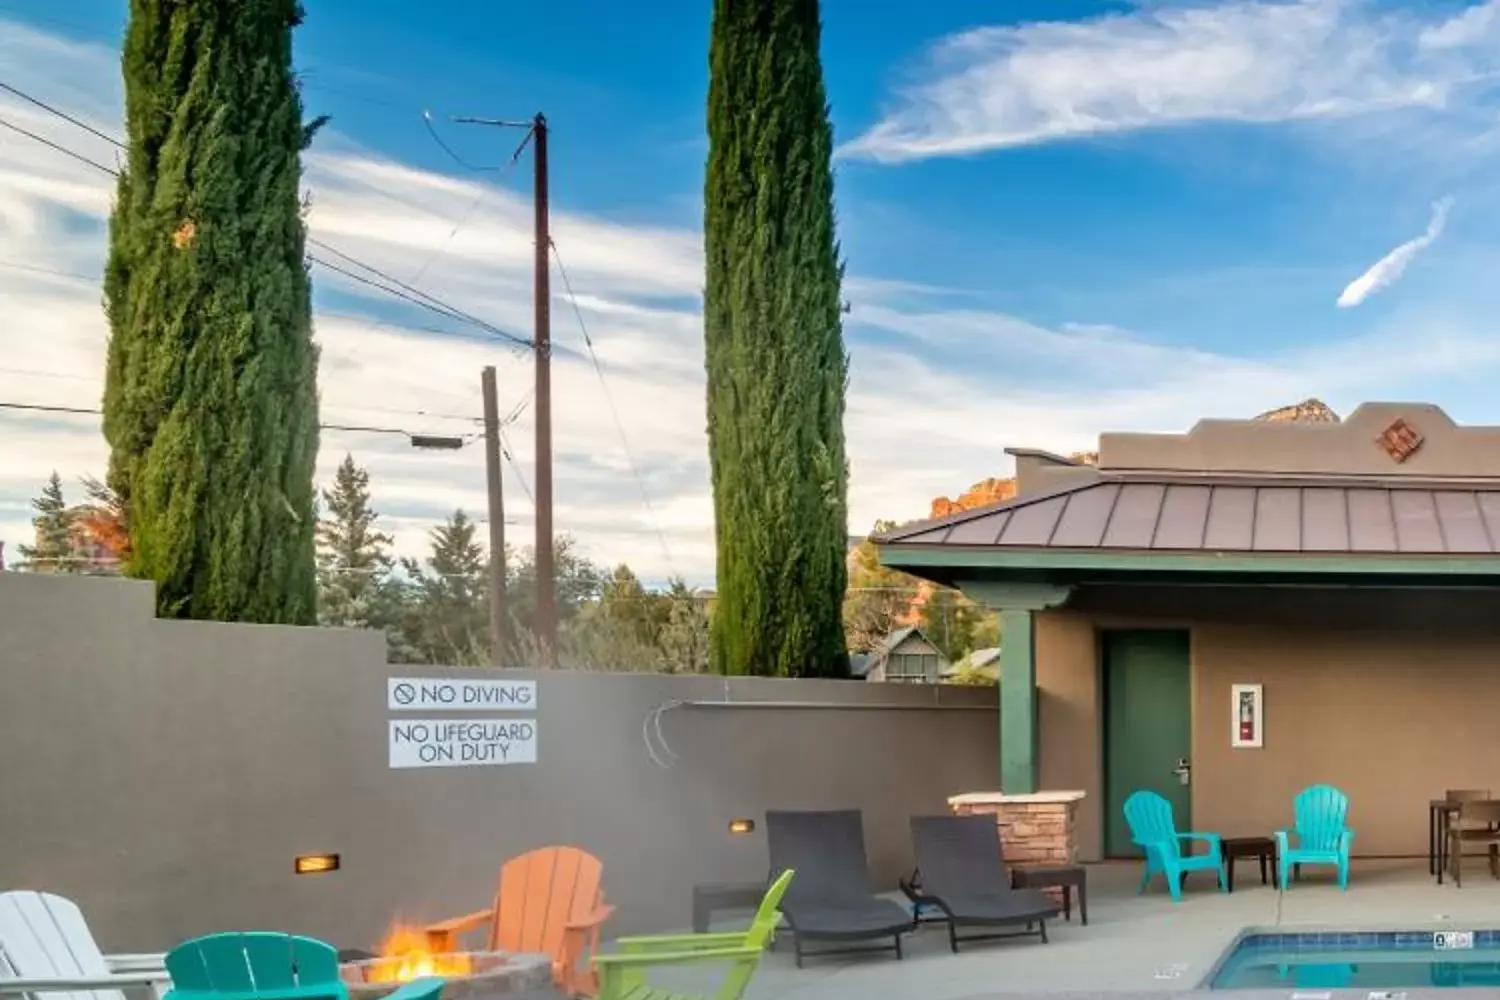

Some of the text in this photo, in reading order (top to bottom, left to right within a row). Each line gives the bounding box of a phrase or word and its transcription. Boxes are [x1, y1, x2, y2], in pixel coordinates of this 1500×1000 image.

[421, 685, 532, 704] NO DIVING
[395, 723, 533, 743] NO LIFEGUARD
[419, 743, 509, 763] ON DUTY
